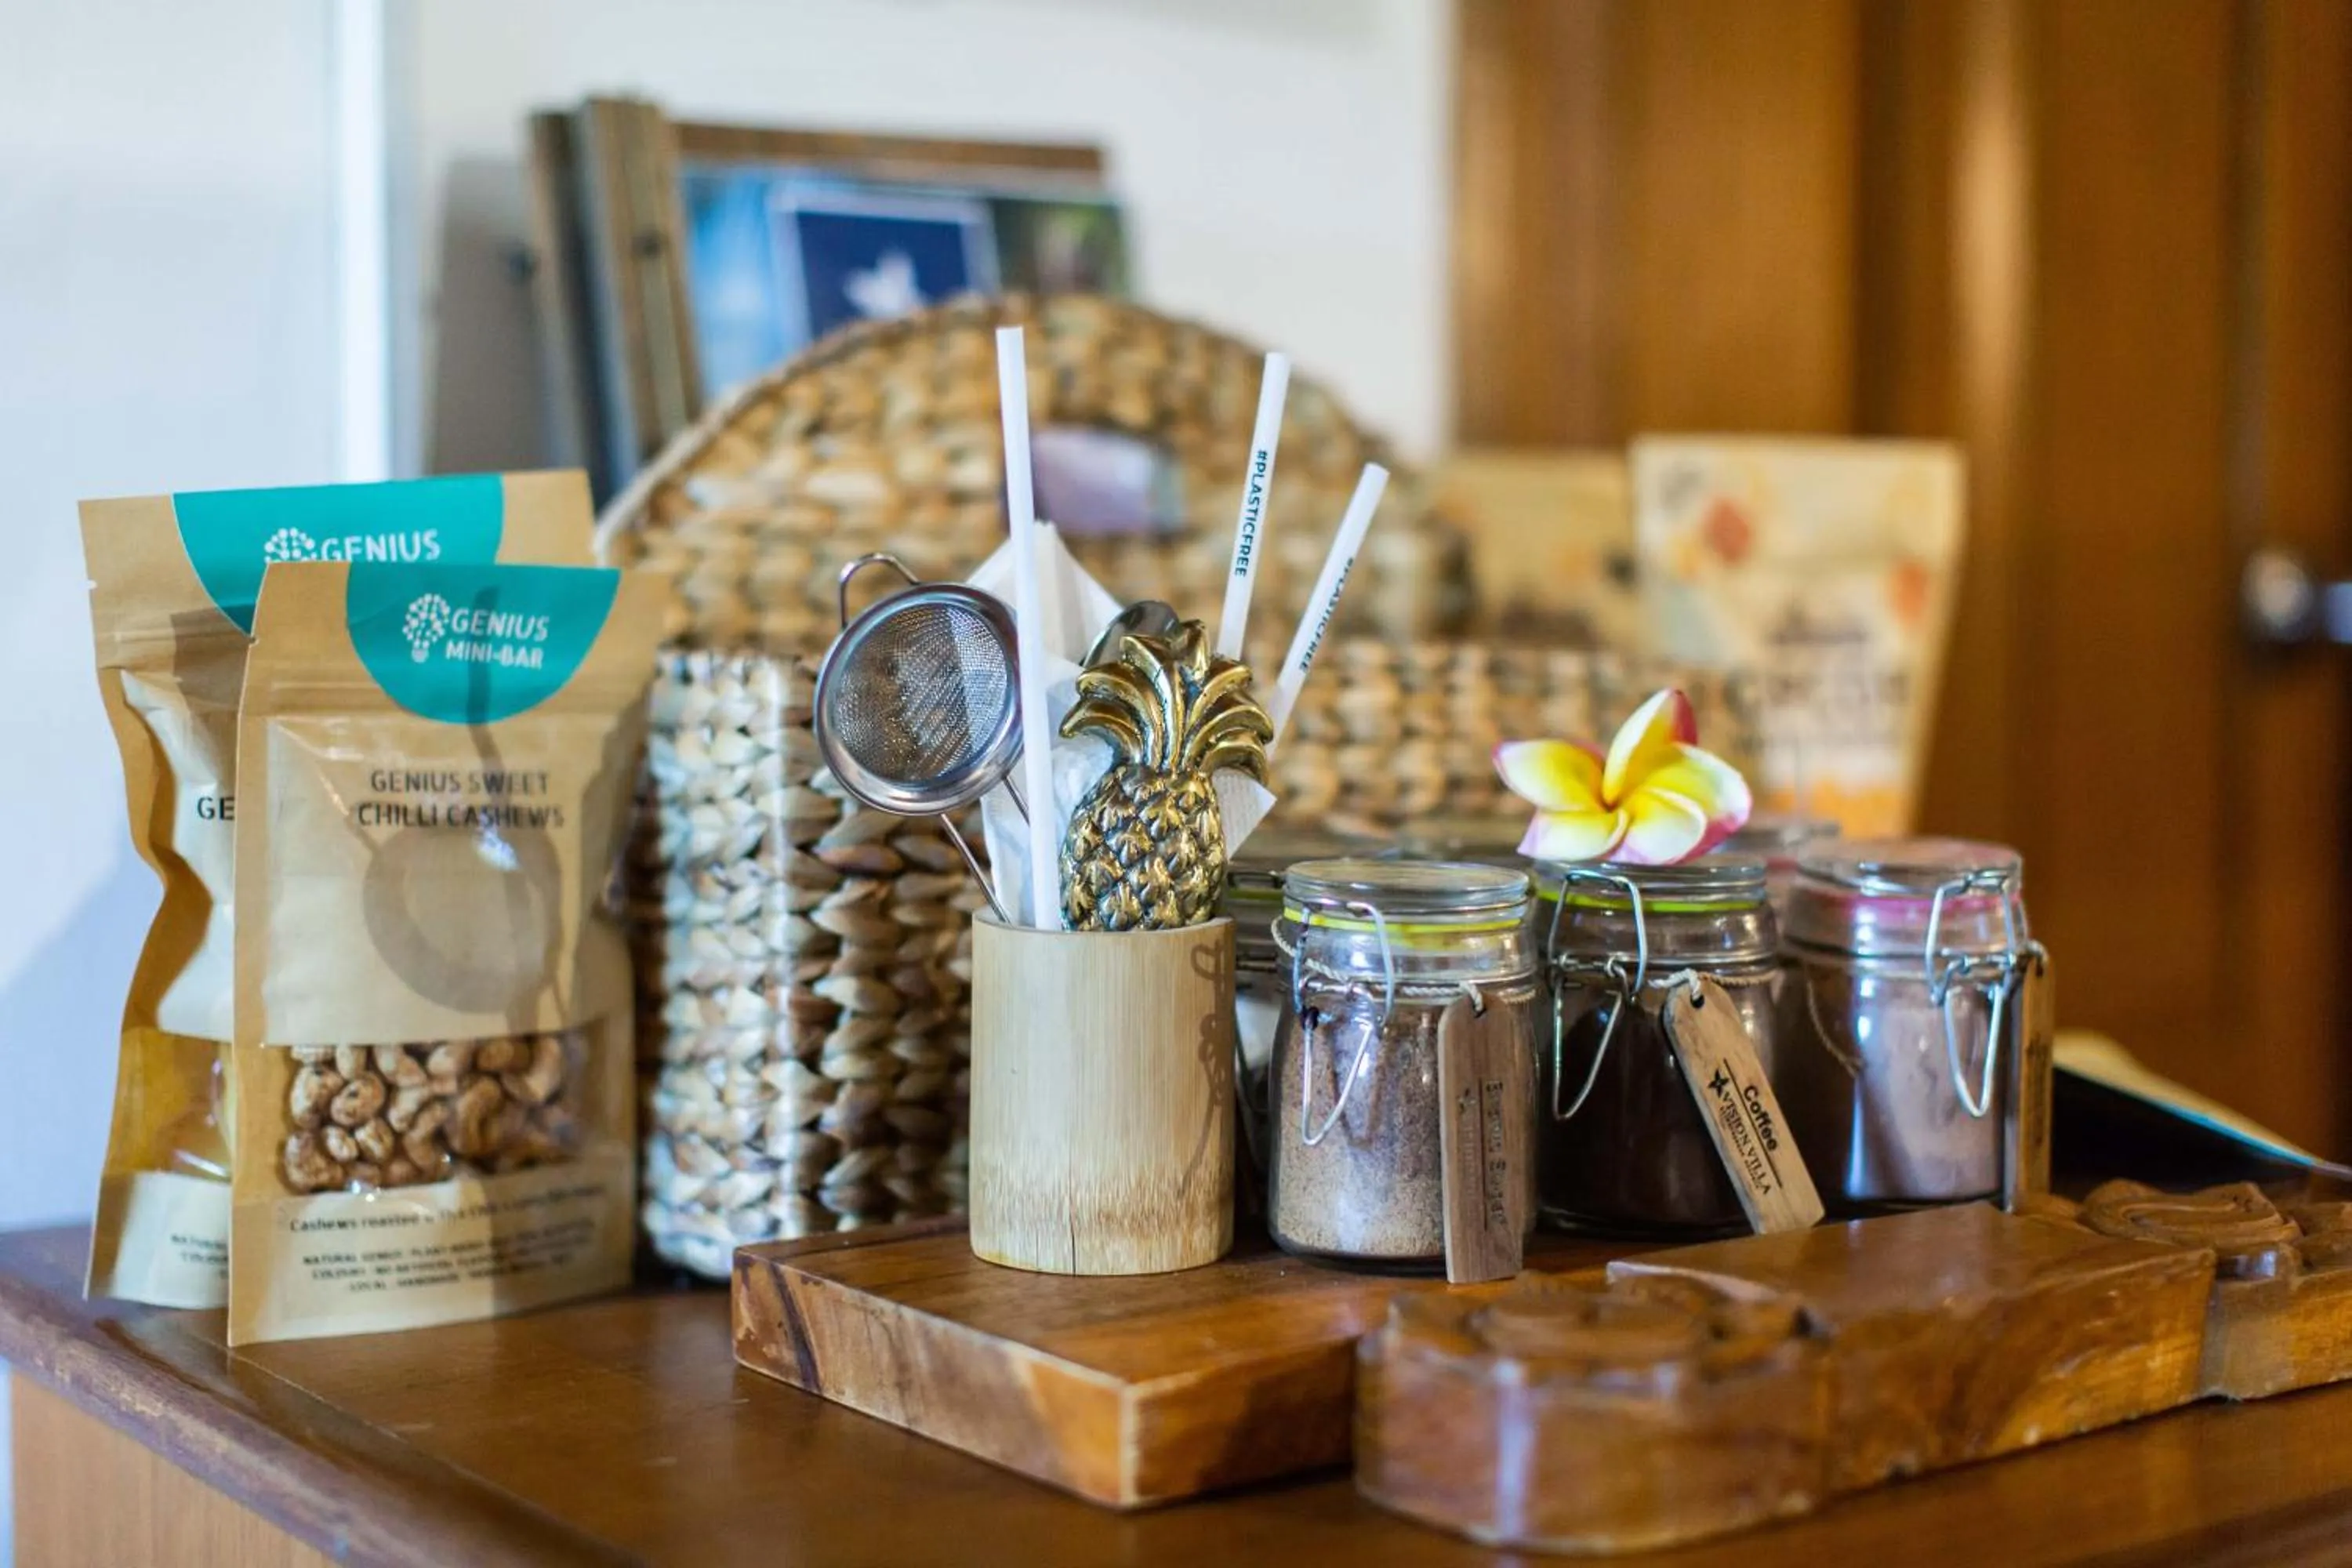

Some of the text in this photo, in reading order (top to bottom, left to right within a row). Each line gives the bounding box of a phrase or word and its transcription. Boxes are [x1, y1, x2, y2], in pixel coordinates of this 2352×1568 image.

[1233, 449, 1268, 578] #PLASTICFREE
[320, 528, 441, 563] GENIUS
[451, 608, 550, 642] GENIUS
[445, 639, 545, 670] MINI-BAR
[370, 770, 549, 795] GENIUS SWEET
[357, 802, 564, 829] CHILLI CASHEWS
[1743, 1084, 1778, 1152] Coffee
[1722, 1091, 1752, 1149] VISION
[1746, 1145, 1772, 1195] VILLA
